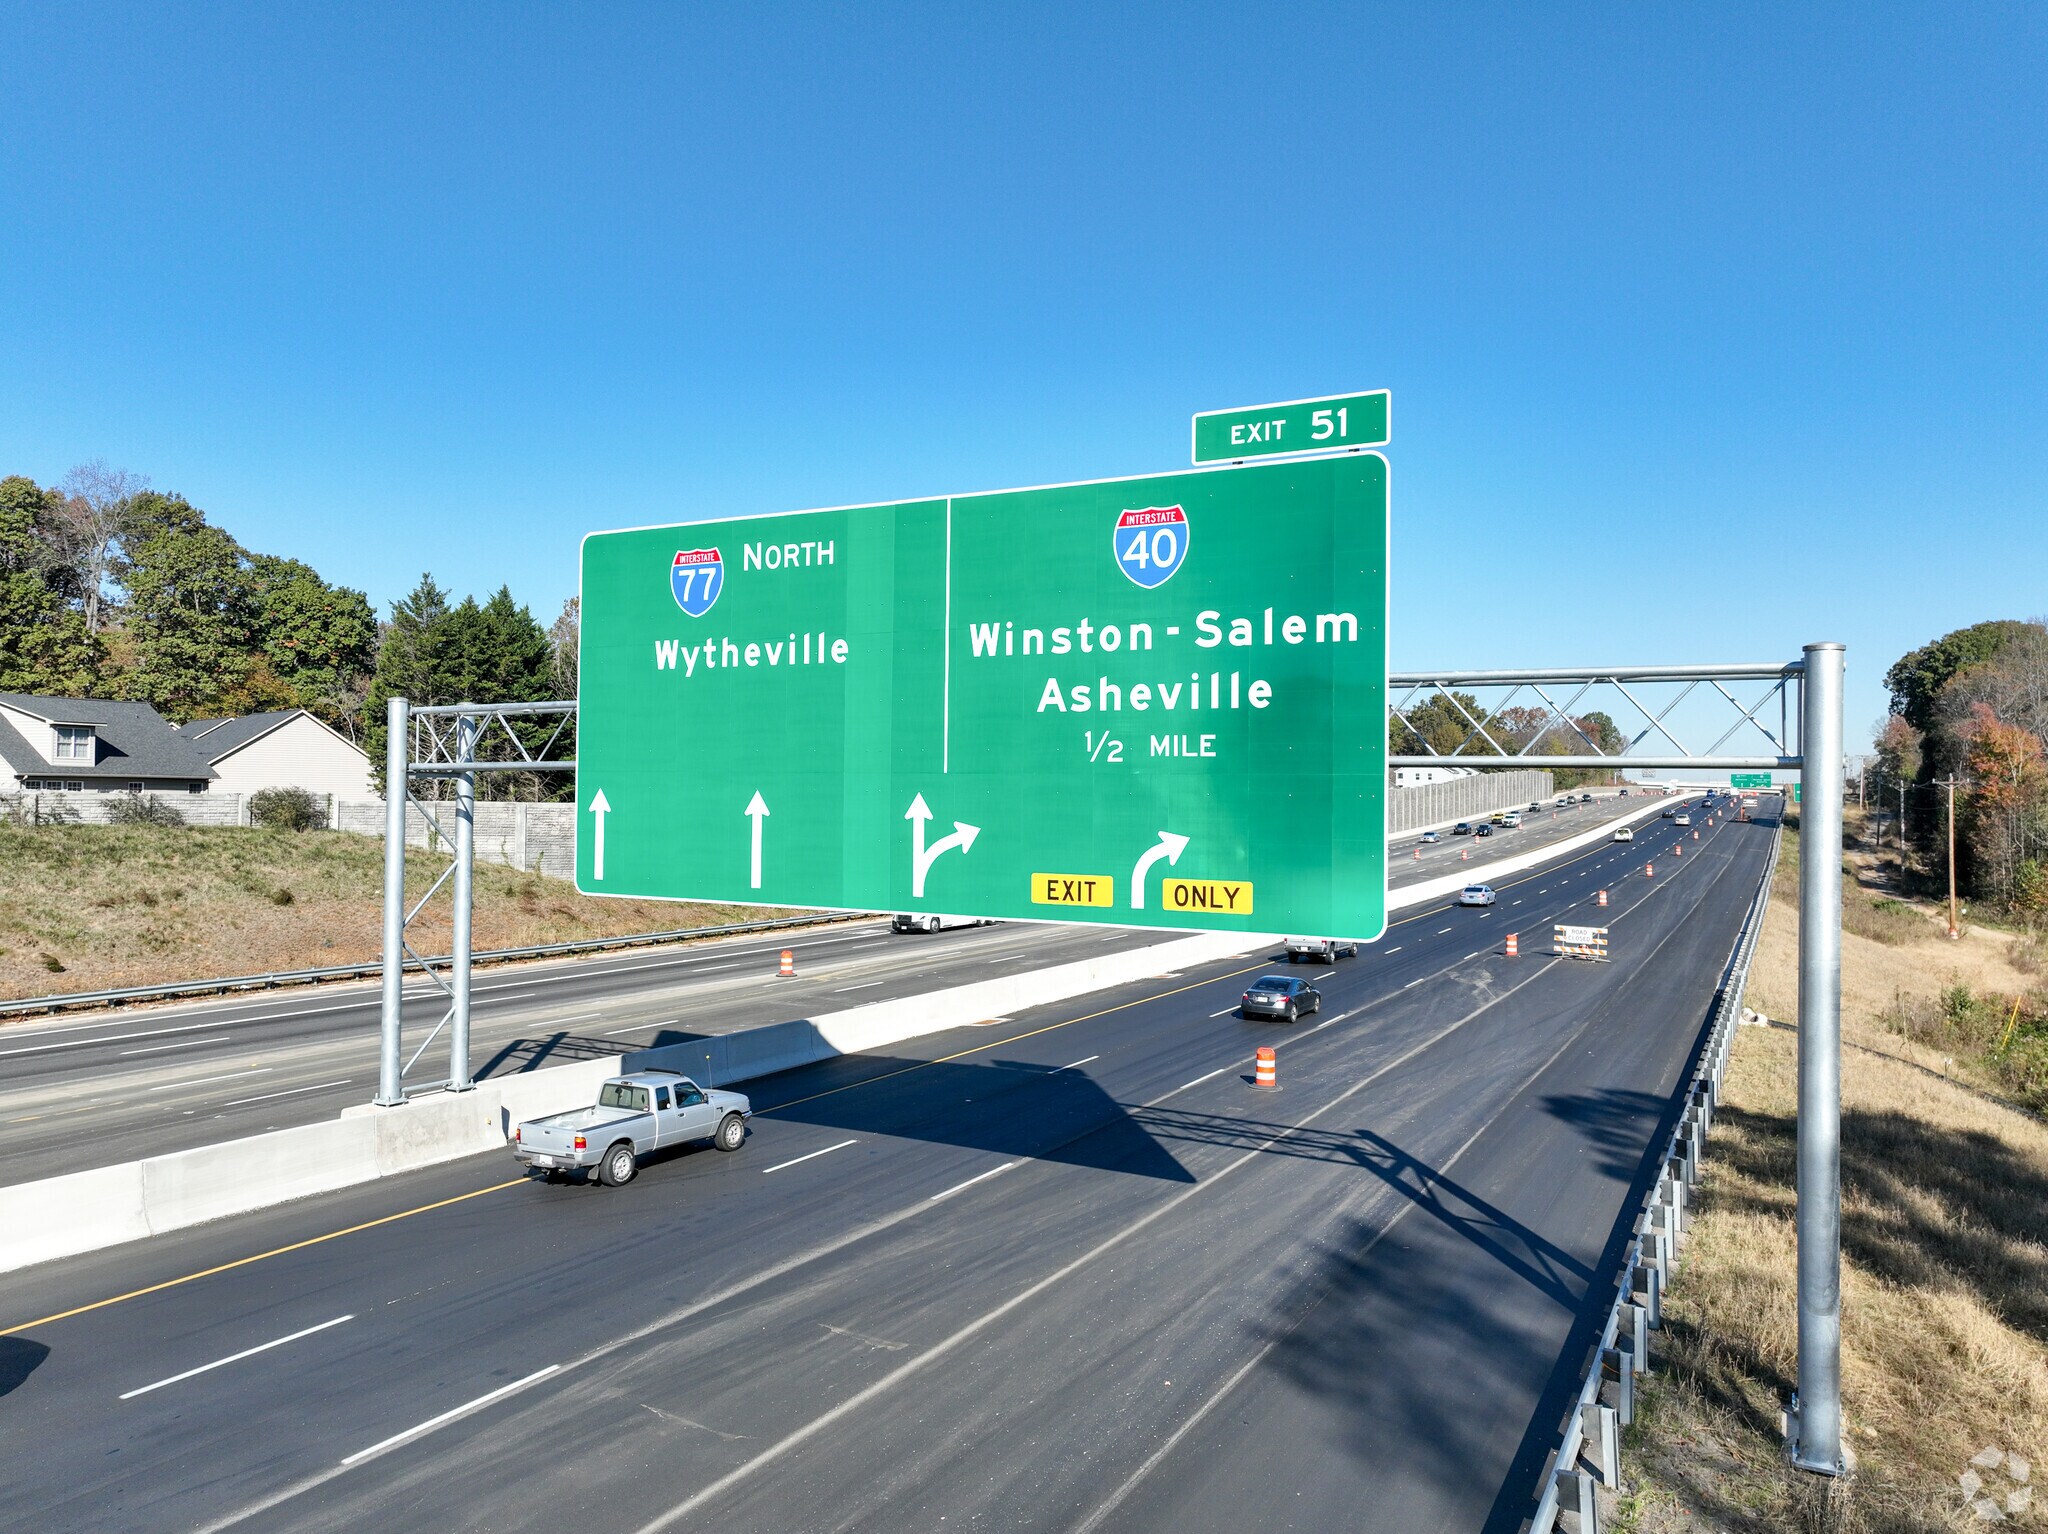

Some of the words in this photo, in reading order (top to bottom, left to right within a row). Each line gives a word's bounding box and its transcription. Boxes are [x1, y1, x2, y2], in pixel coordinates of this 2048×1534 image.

[1230, 419, 1286, 445] EXIT
[1310, 407, 1348, 440] 51
[1126, 511, 1177, 525] INTERSTATE
[679, 552, 716, 564] INTERSTATE
[743, 540, 834, 571] NORTH
[1122, 528, 1178, 569] 40
[678, 567, 717, 602] 77
[654, 631, 849, 678] Wytheville
[1036, 671, 1273, 713] Asheville
[1150, 734, 1217, 757] MILE
[1047, 879, 1096, 903] EXIT
[1174, 884, 1240, 909] ONLY
[1571, 928, 1588, 936] ROAD
